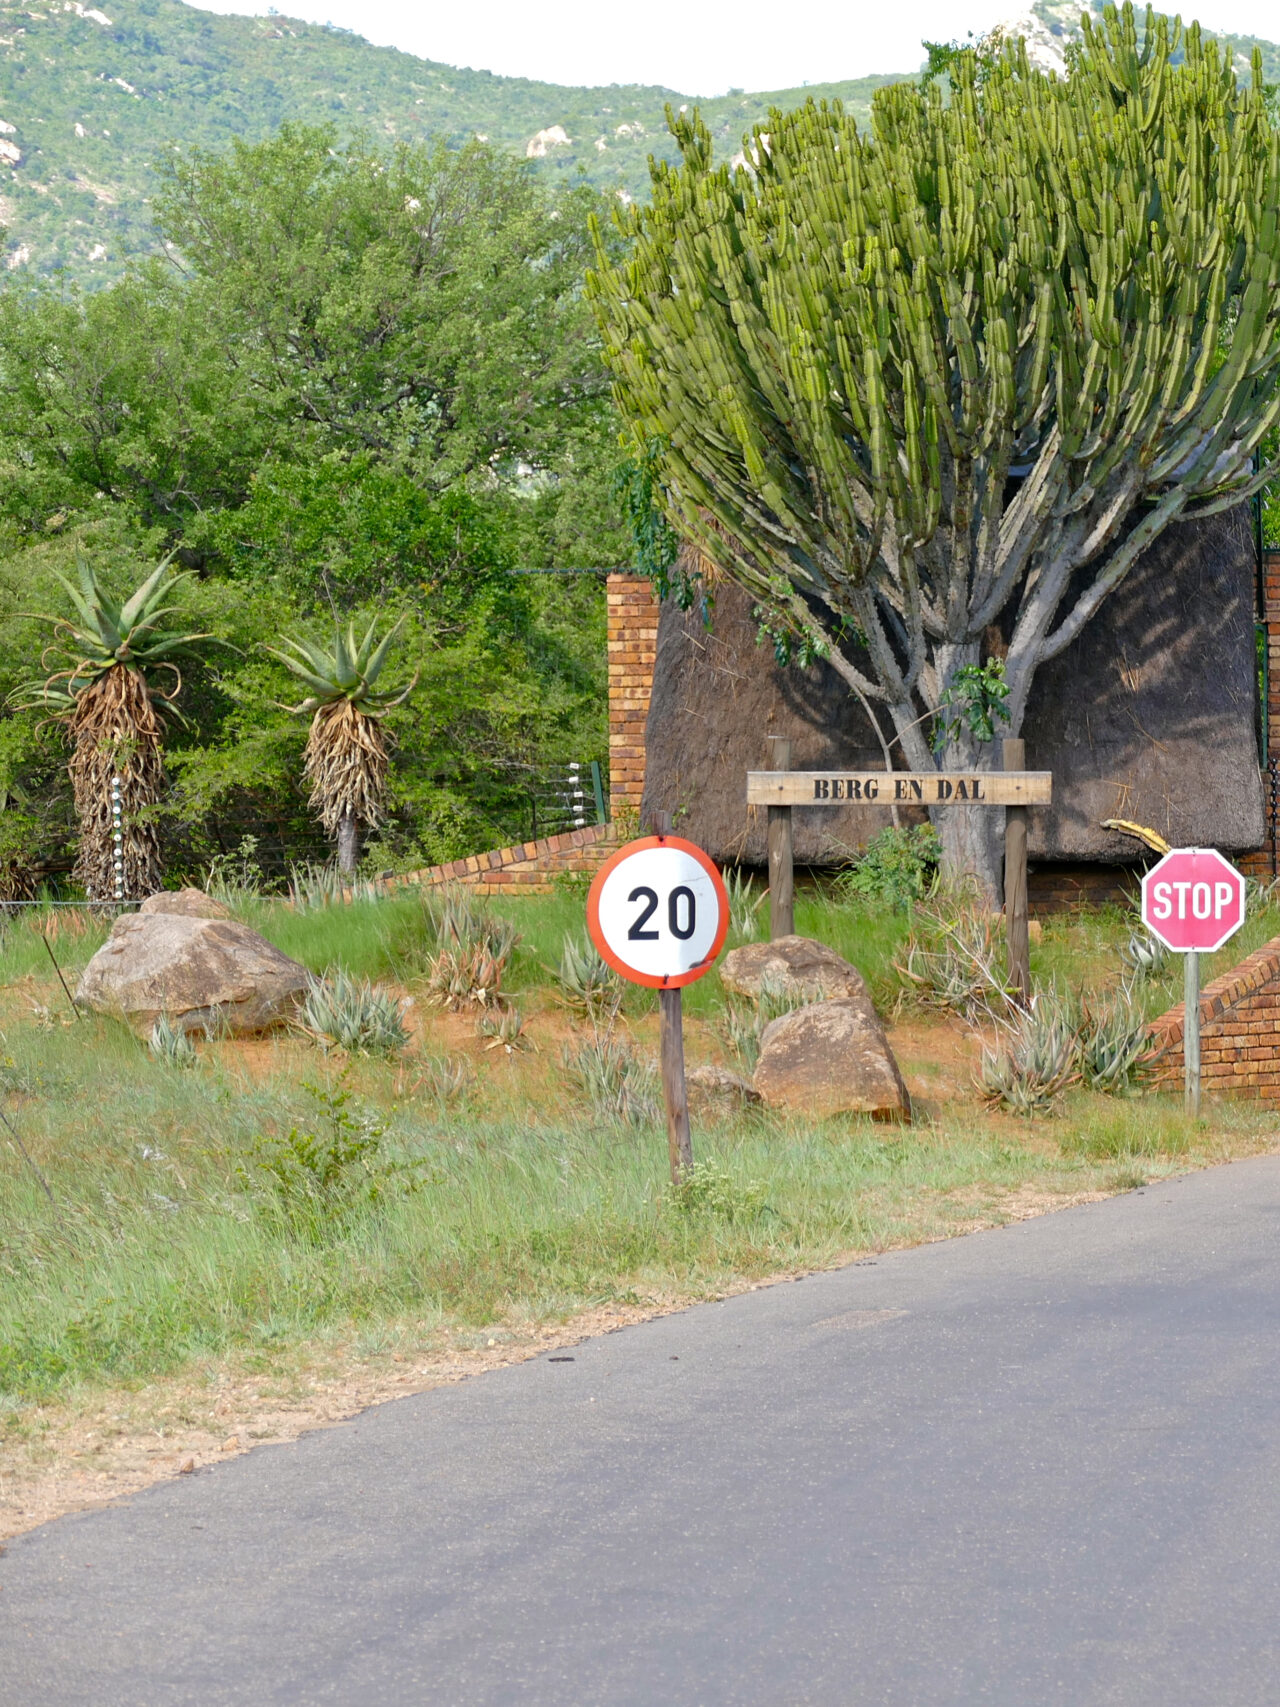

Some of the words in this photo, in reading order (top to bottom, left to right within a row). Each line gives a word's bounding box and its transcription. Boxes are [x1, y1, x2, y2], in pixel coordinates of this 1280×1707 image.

[813, 778, 879, 800] BERG
[894, 779, 923, 800] EN
[937, 779, 986, 800] DAL
[627, 885, 696, 941] 20
[1153, 881, 1233, 920] STOP
